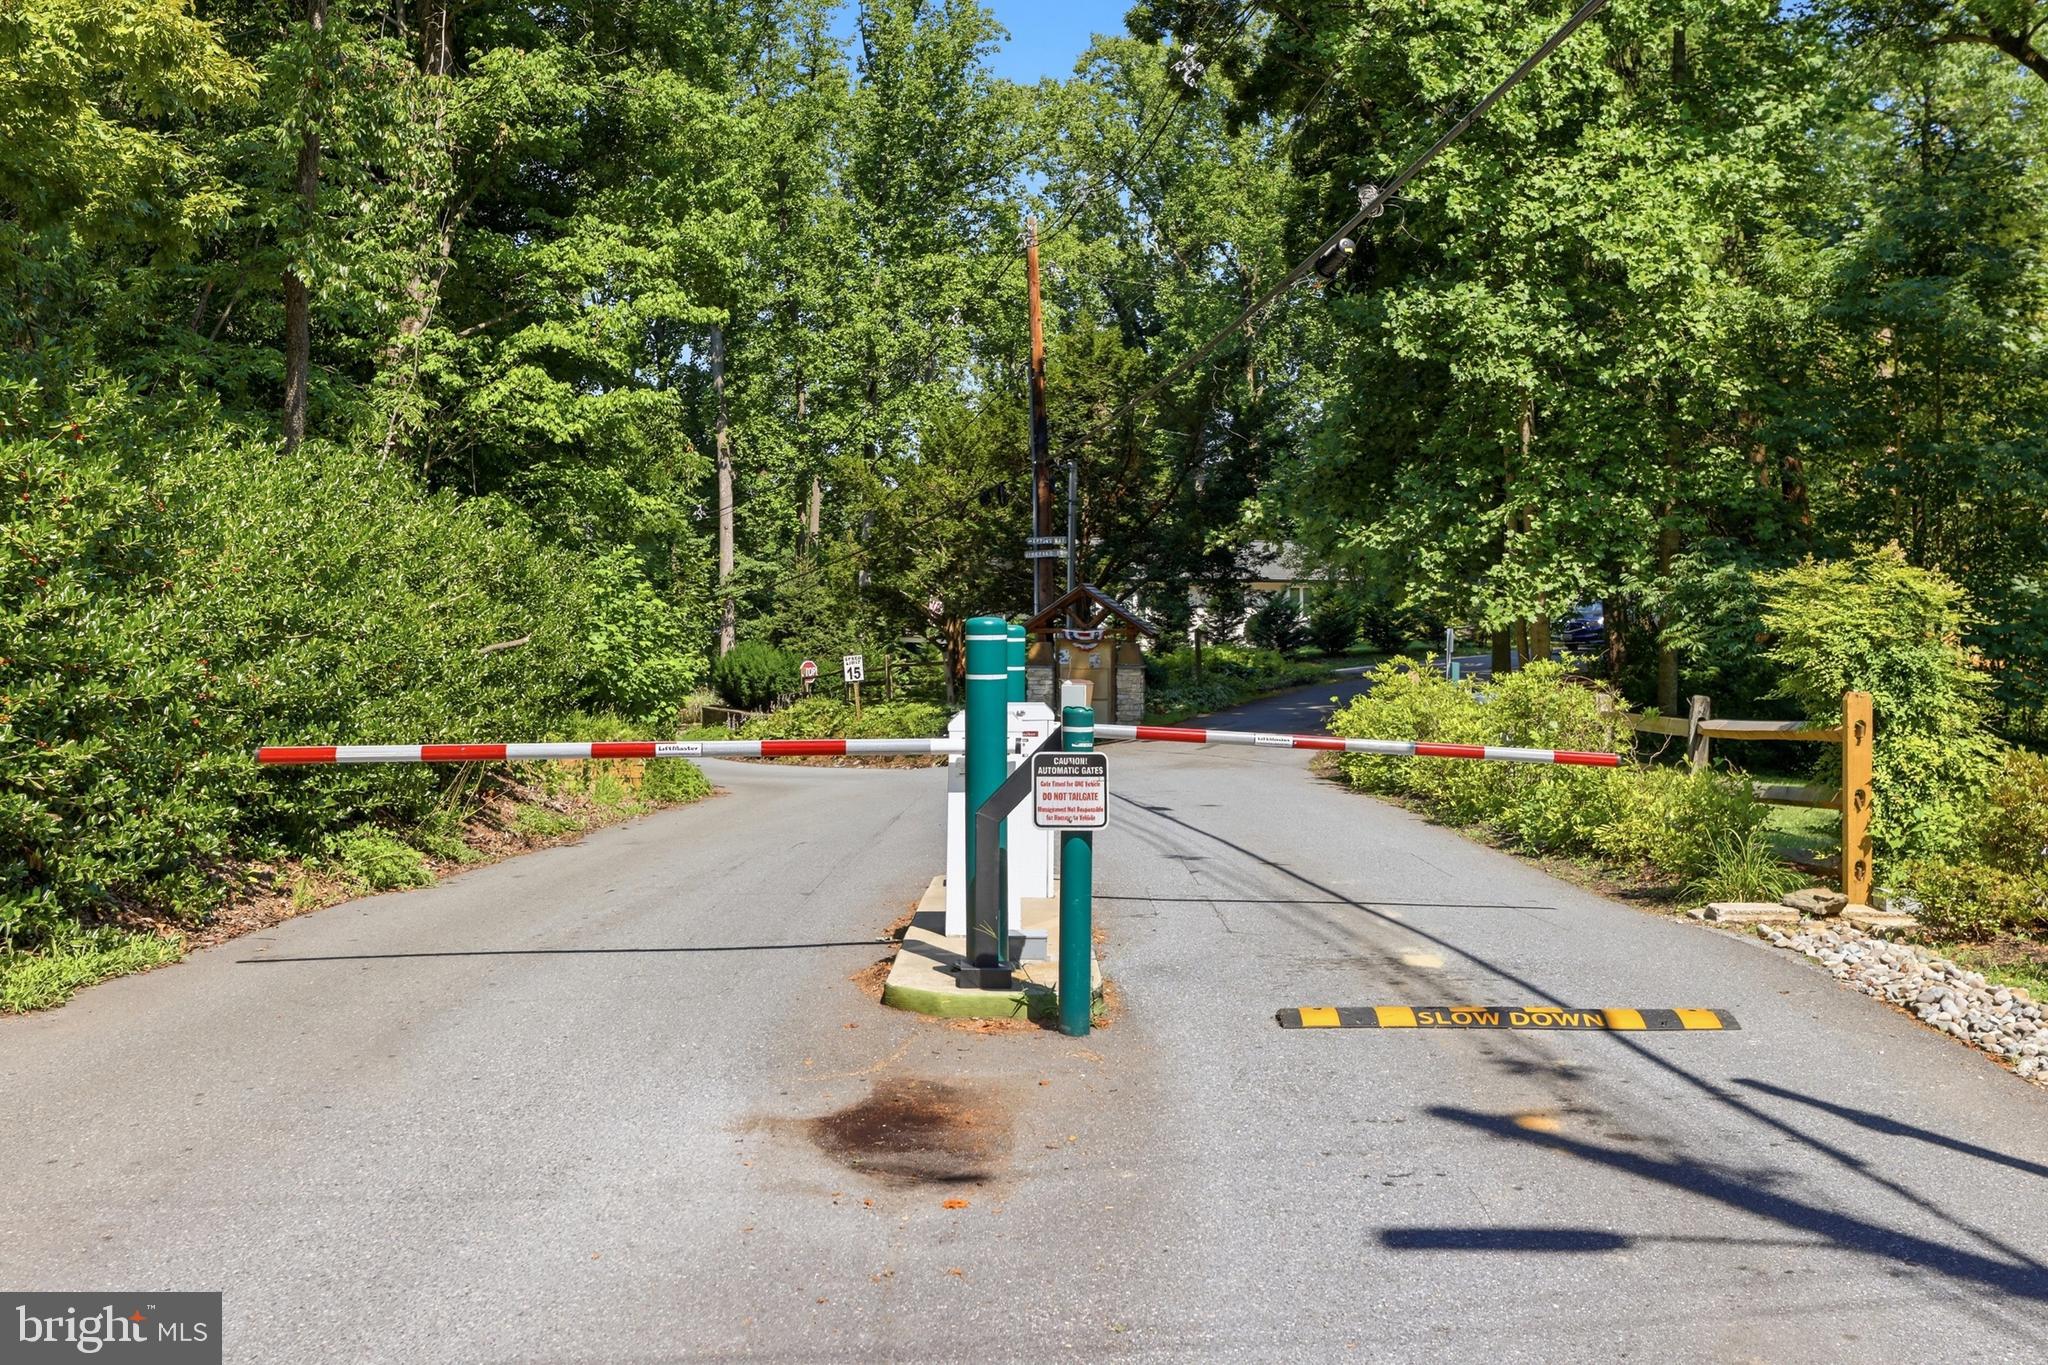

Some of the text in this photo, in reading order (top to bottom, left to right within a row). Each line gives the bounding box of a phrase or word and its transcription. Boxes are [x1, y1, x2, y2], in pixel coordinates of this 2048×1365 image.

[846, 666, 860, 680] 15
[1054, 757, 1088, 765] CAUTION!
[1038, 766, 1104, 774] AUTOMATIC GATES
[1069, 792, 1098, 800] TAILGATE
[1419, 1011, 1606, 1027] SLOW DOWN
